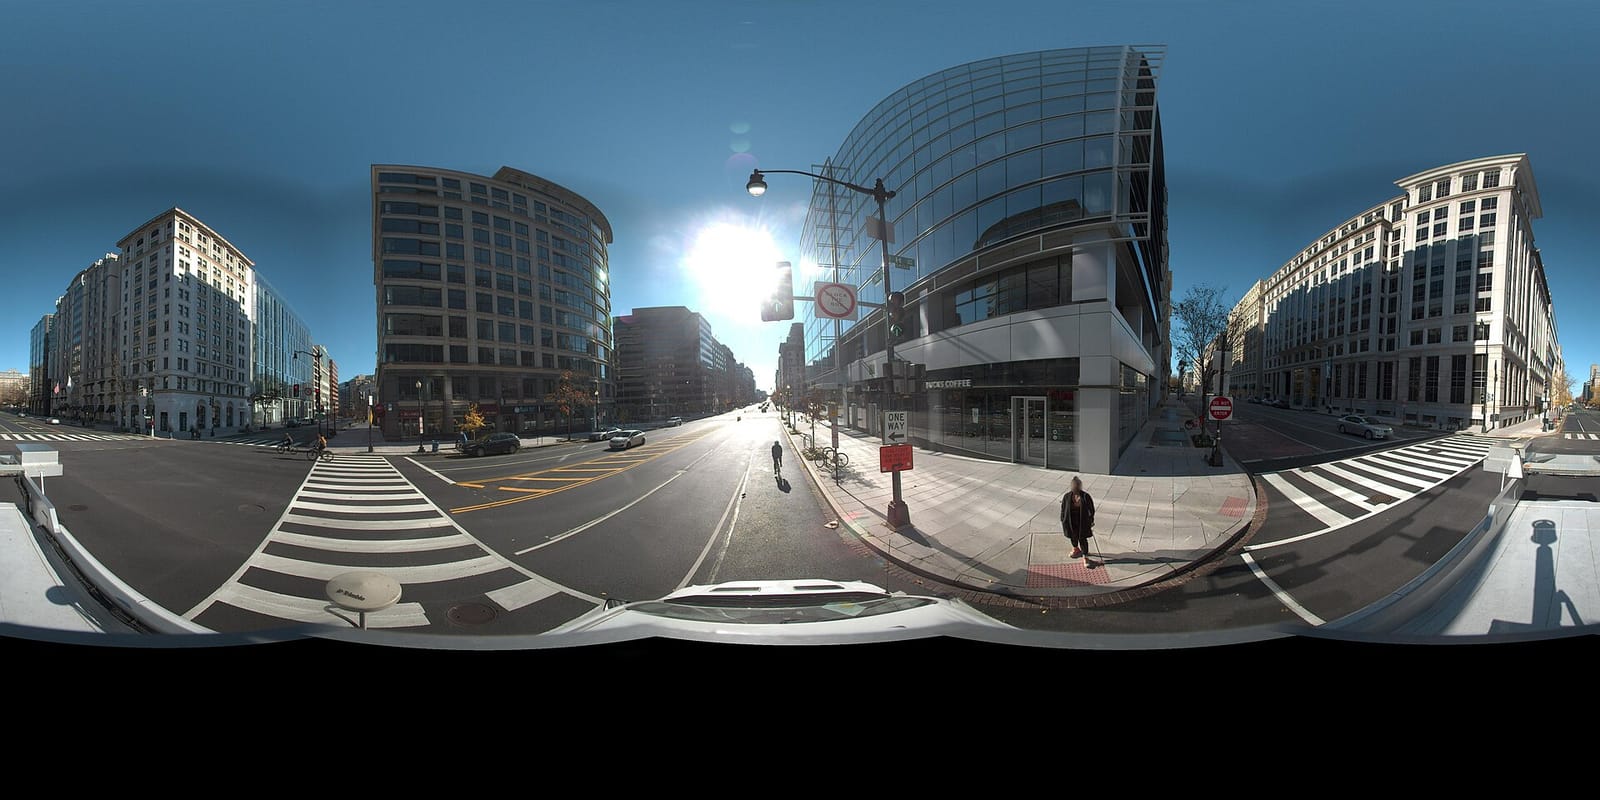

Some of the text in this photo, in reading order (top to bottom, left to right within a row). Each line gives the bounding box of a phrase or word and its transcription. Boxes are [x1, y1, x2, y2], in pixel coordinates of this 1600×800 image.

[924, 380, 971, 390] UCKS COFFEE
[888, 413, 904, 421] ONE
[888, 422, 904, 430] WAY
